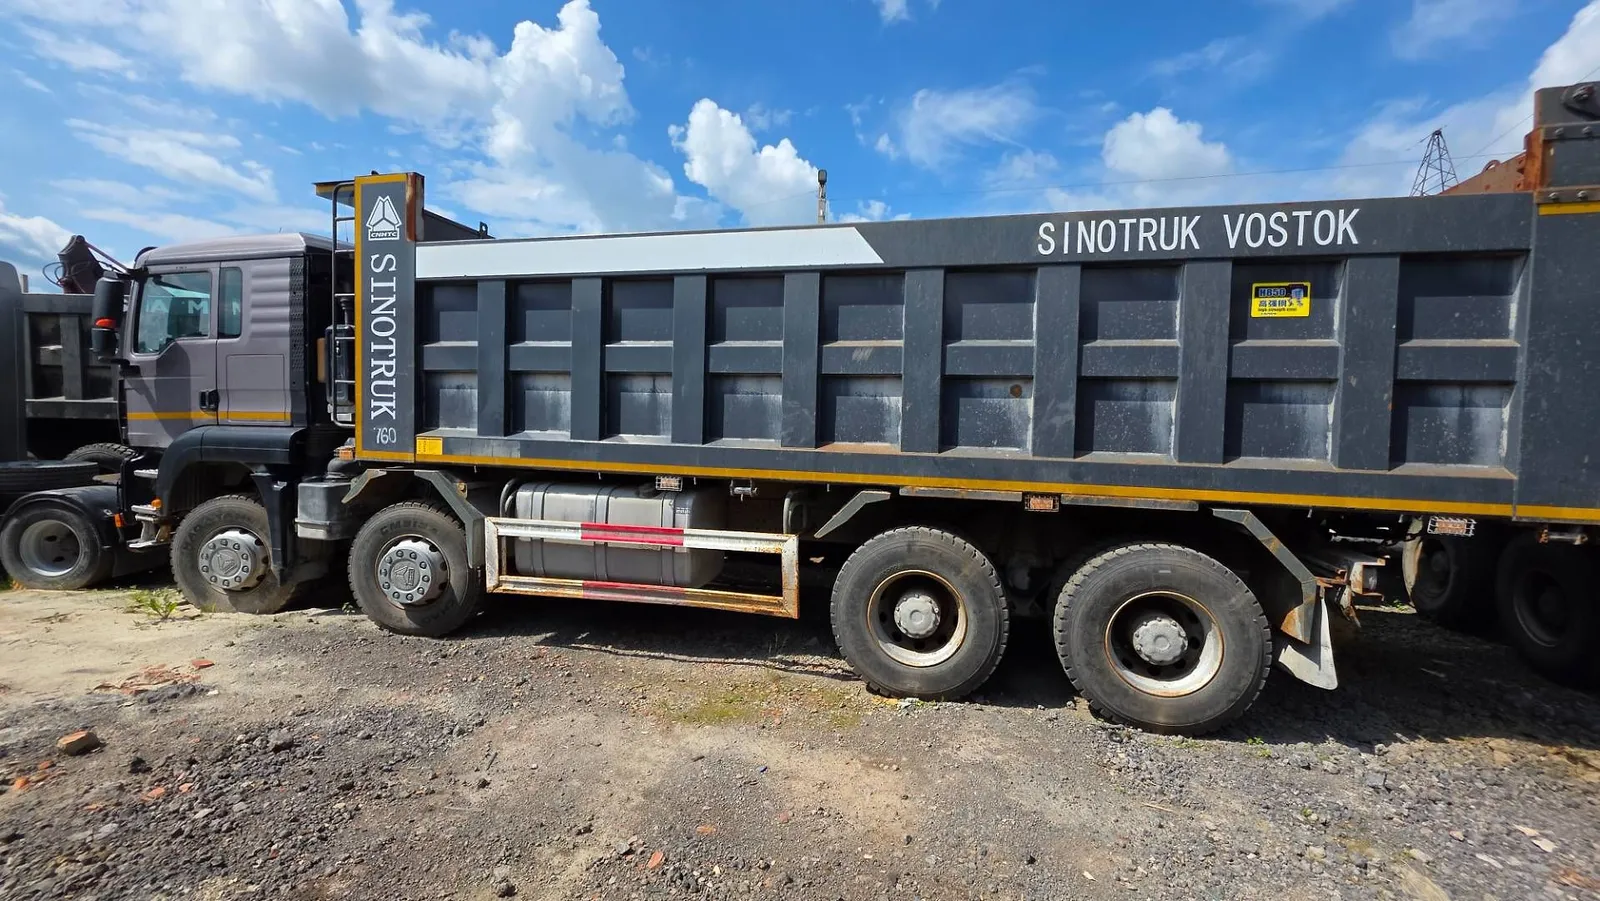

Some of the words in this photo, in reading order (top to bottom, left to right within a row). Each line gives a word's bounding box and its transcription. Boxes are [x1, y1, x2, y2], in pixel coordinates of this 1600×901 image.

[1037, 215, 1200, 255] SINOTRUK
[1223, 208, 1360, 249] VOSTOK
[370, 253, 397, 420] SINOTRUK
[375, 427, 397, 445] 760
